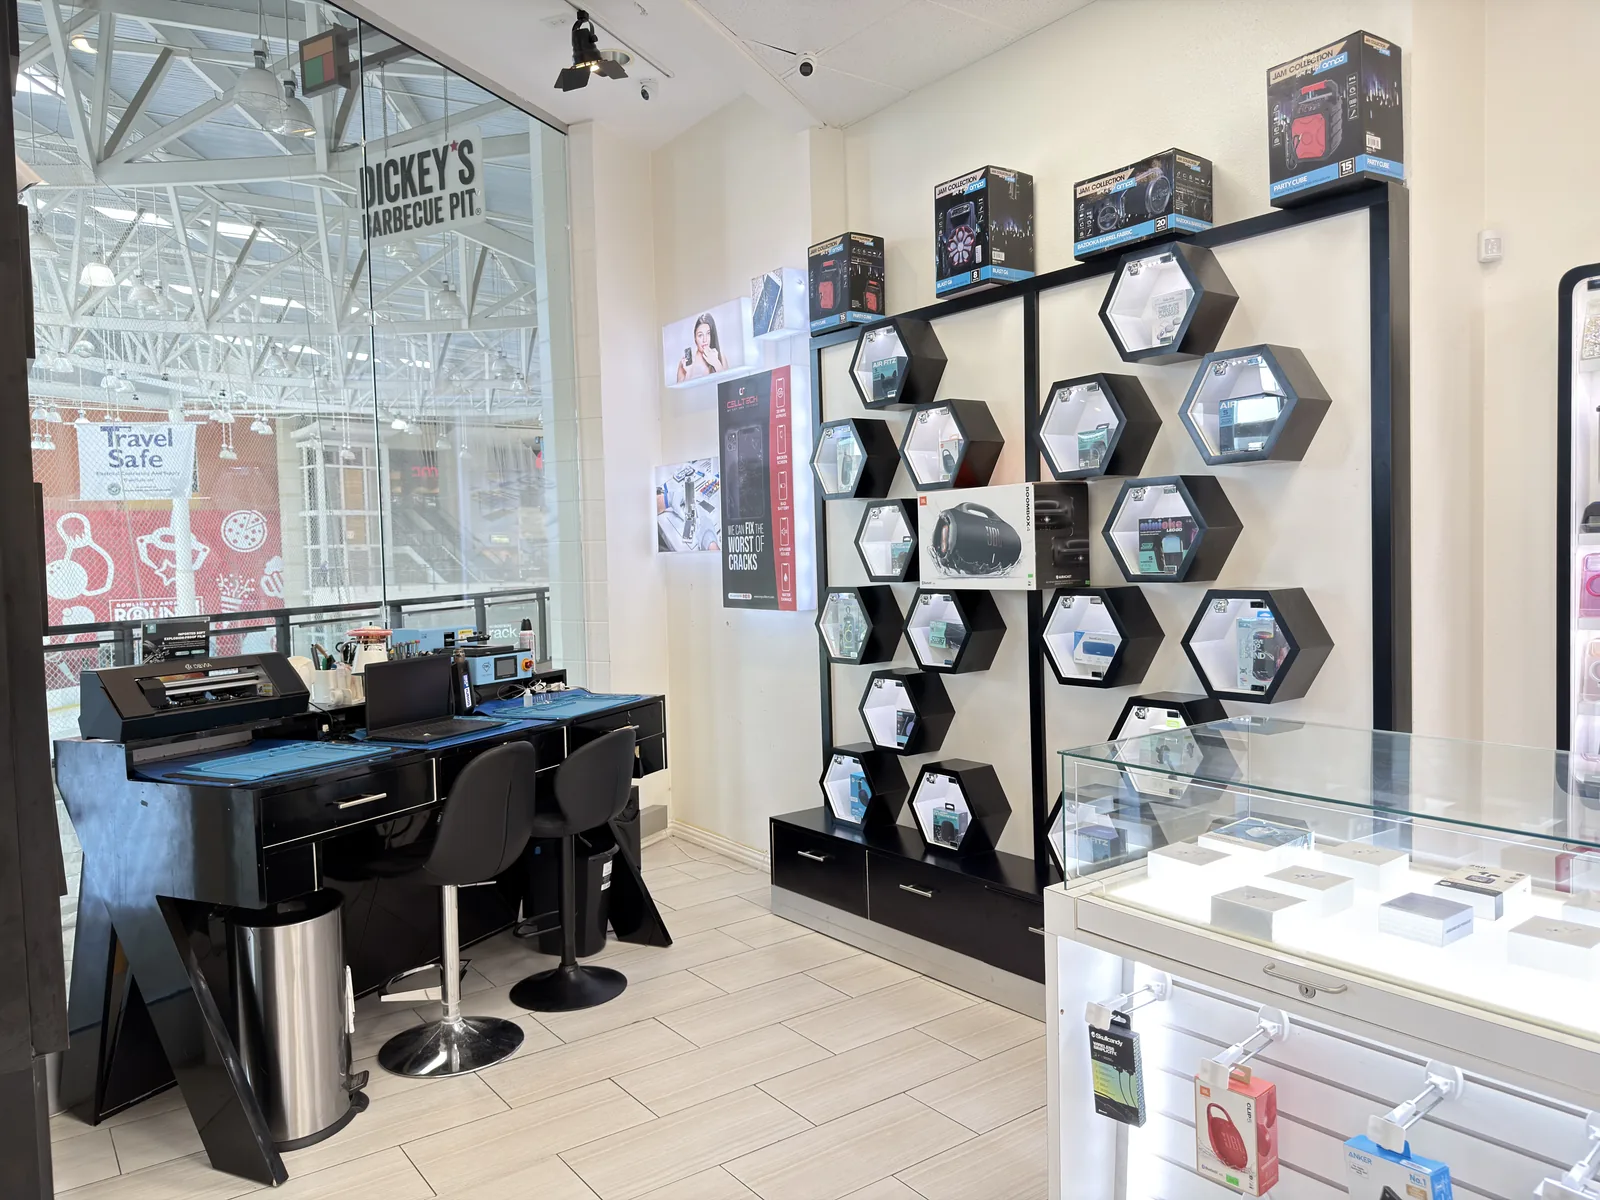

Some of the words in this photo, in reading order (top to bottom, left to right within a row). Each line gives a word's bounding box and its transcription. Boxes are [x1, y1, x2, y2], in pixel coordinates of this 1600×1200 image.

[1272, 69, 1288, 81] JAM
[1341, 161, 1352, 171] 15
[1273, 179, 1292, 193] PARTY
[1292, 176, 1307, 187] CUBE
[362, 196, 444, 240] BARBECUE
[1156, 219, 1166, 227] 20
[972, 270, 978, 278] 8
[100, 426, 173, 448] Travel
[108, 448, 163, 468] Safe
[728, 525, 735, 536] WE
[735, 524, 745, 535] CAN
[745, 521, 755, 535] FIX
[755, 523, 764, 535] THE
[728, 536, 754, 553] WORST
[755, 535, 765, 553] OF
[728, 553, 758, 571] CRACKS
[1095, 1033, 1123, 1047] Skullcandy
[1348, 1151, 1372, 1166] ANKER
